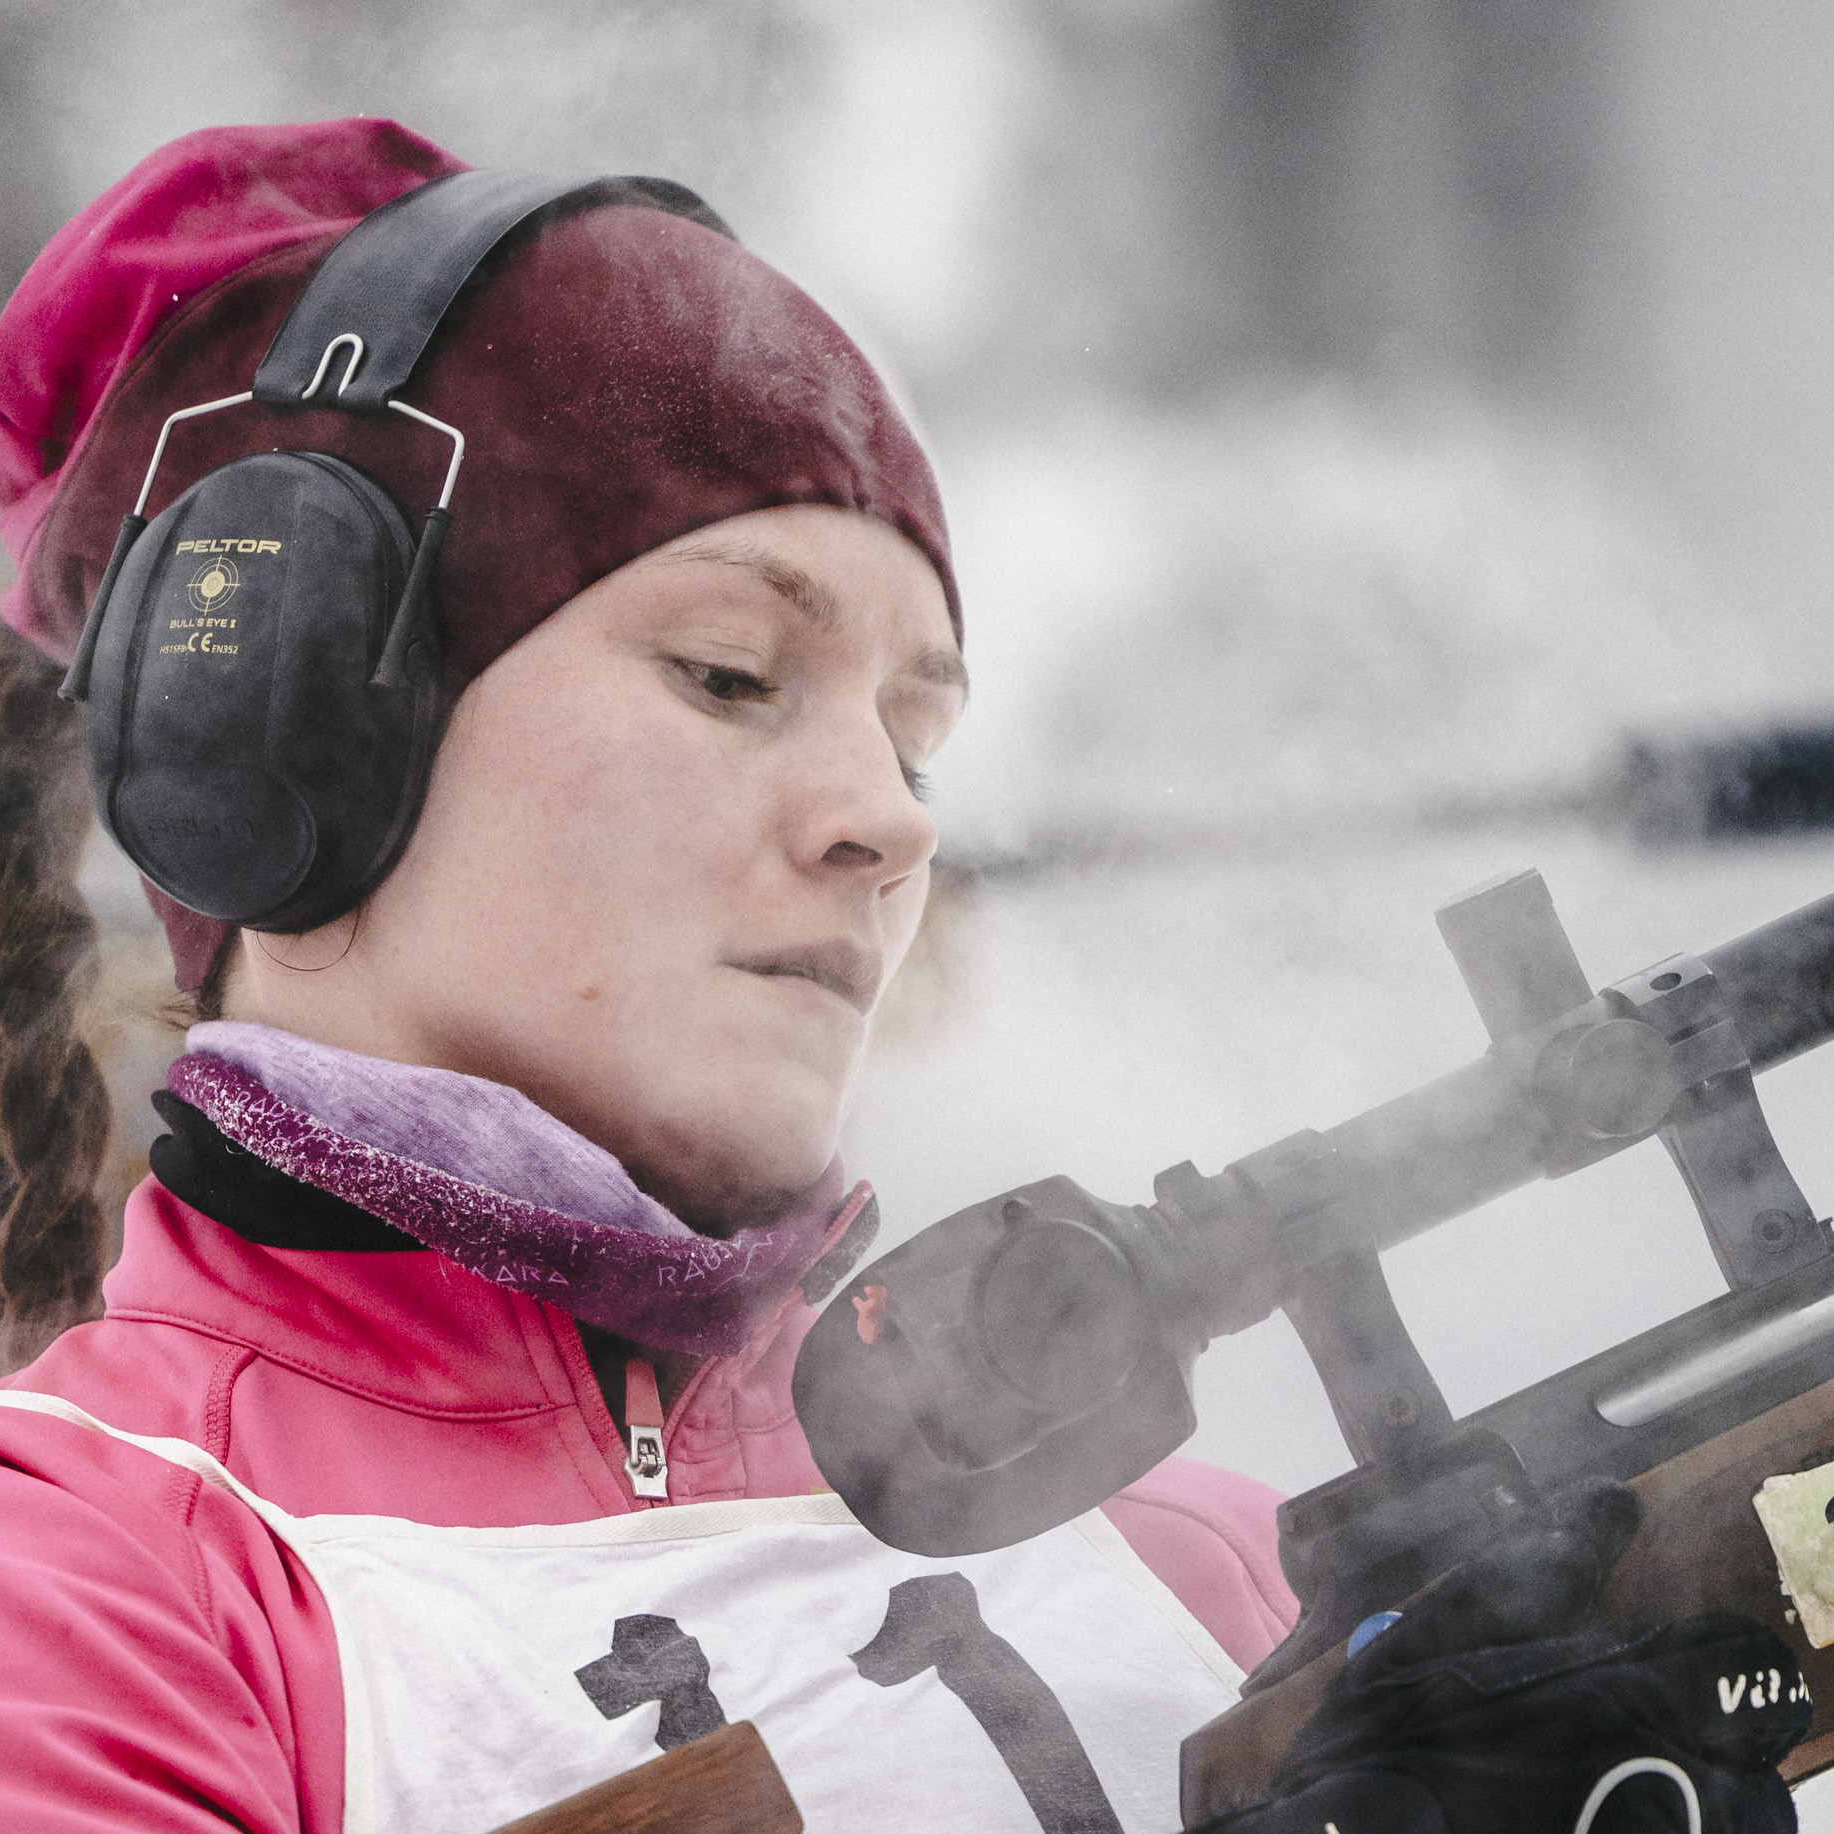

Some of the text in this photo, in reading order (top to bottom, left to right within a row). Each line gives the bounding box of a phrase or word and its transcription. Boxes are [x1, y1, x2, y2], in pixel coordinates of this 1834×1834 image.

[175, 538, 282, 556] PELTOR
[169, 618, 204, 629] BULL'S
[207, 618, 228, 628] EYE
[211, 644, 239, 655] EN352
